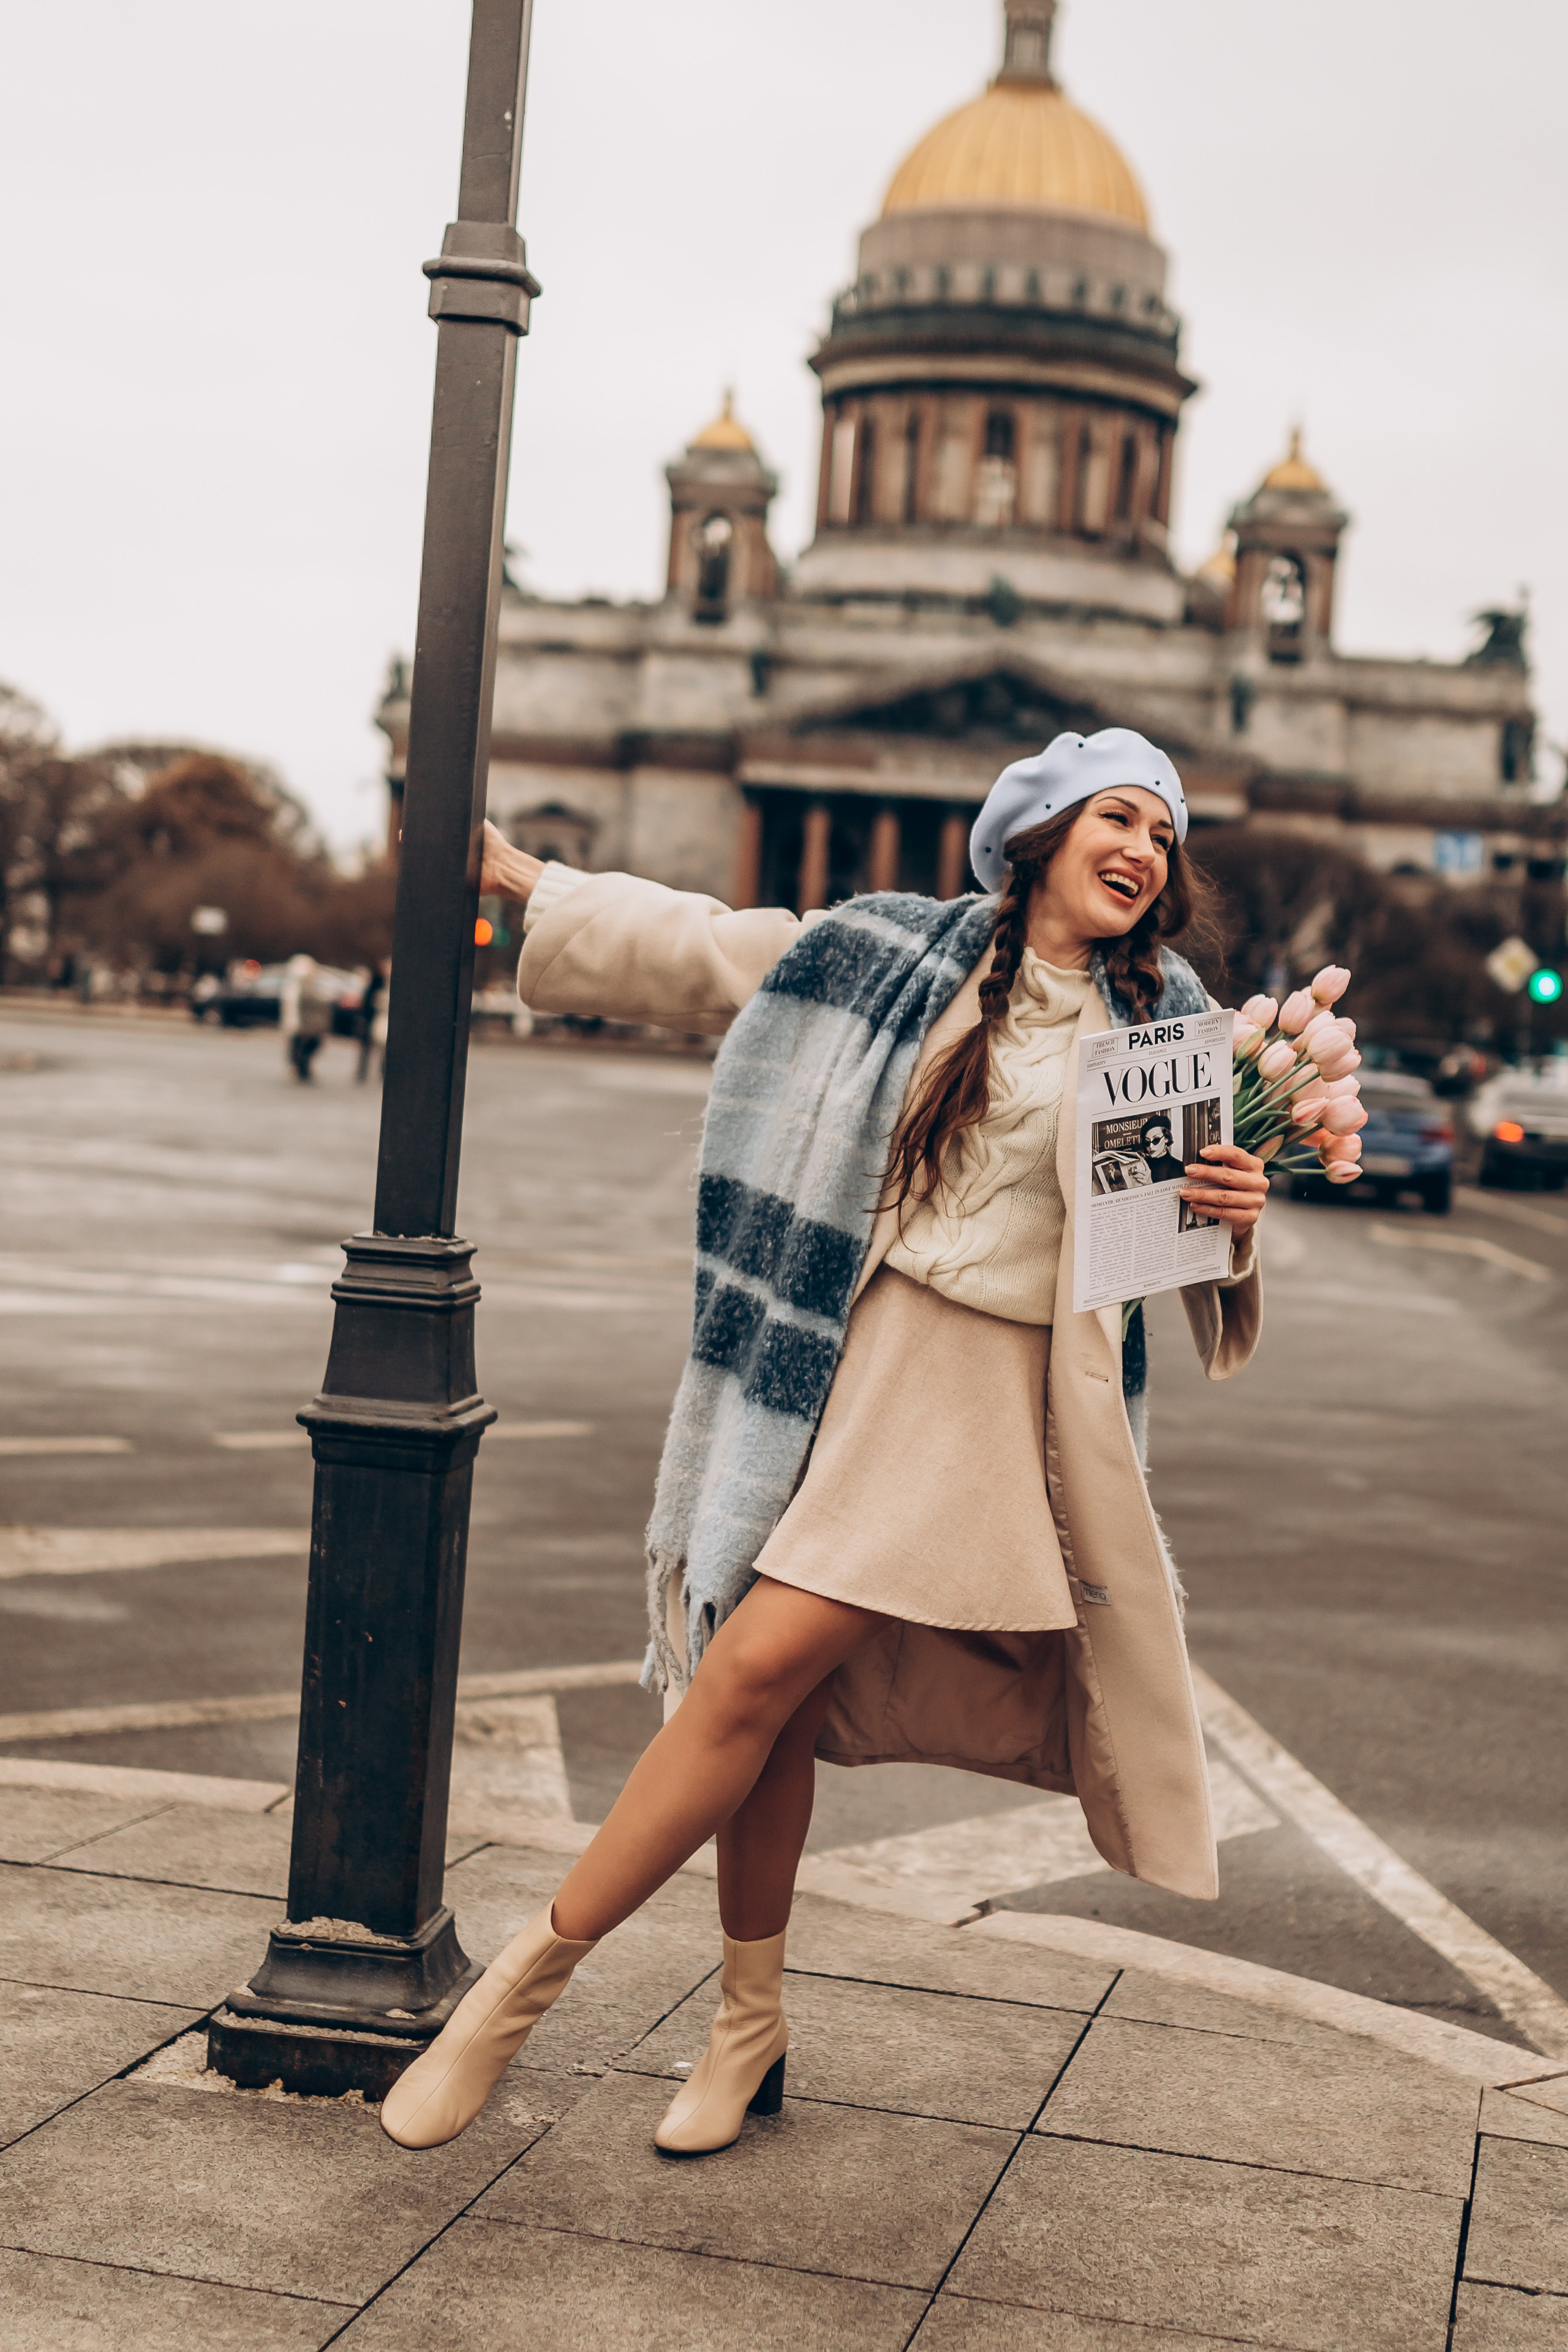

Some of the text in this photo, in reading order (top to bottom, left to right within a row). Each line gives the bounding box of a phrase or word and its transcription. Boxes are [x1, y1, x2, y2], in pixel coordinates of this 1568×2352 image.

[1129, 1023, 1185, 1050] PARIS
[1197, 1026, 1219, 1035] FASHION
[1095, 1046, 1115, 1055] FASHION
[1096, 1039, 1115, 1049] FRENCH
[1101, 1052, 1212, 1106] VOGUE
[1104, 1134, 1140, 1150] OMELETT
